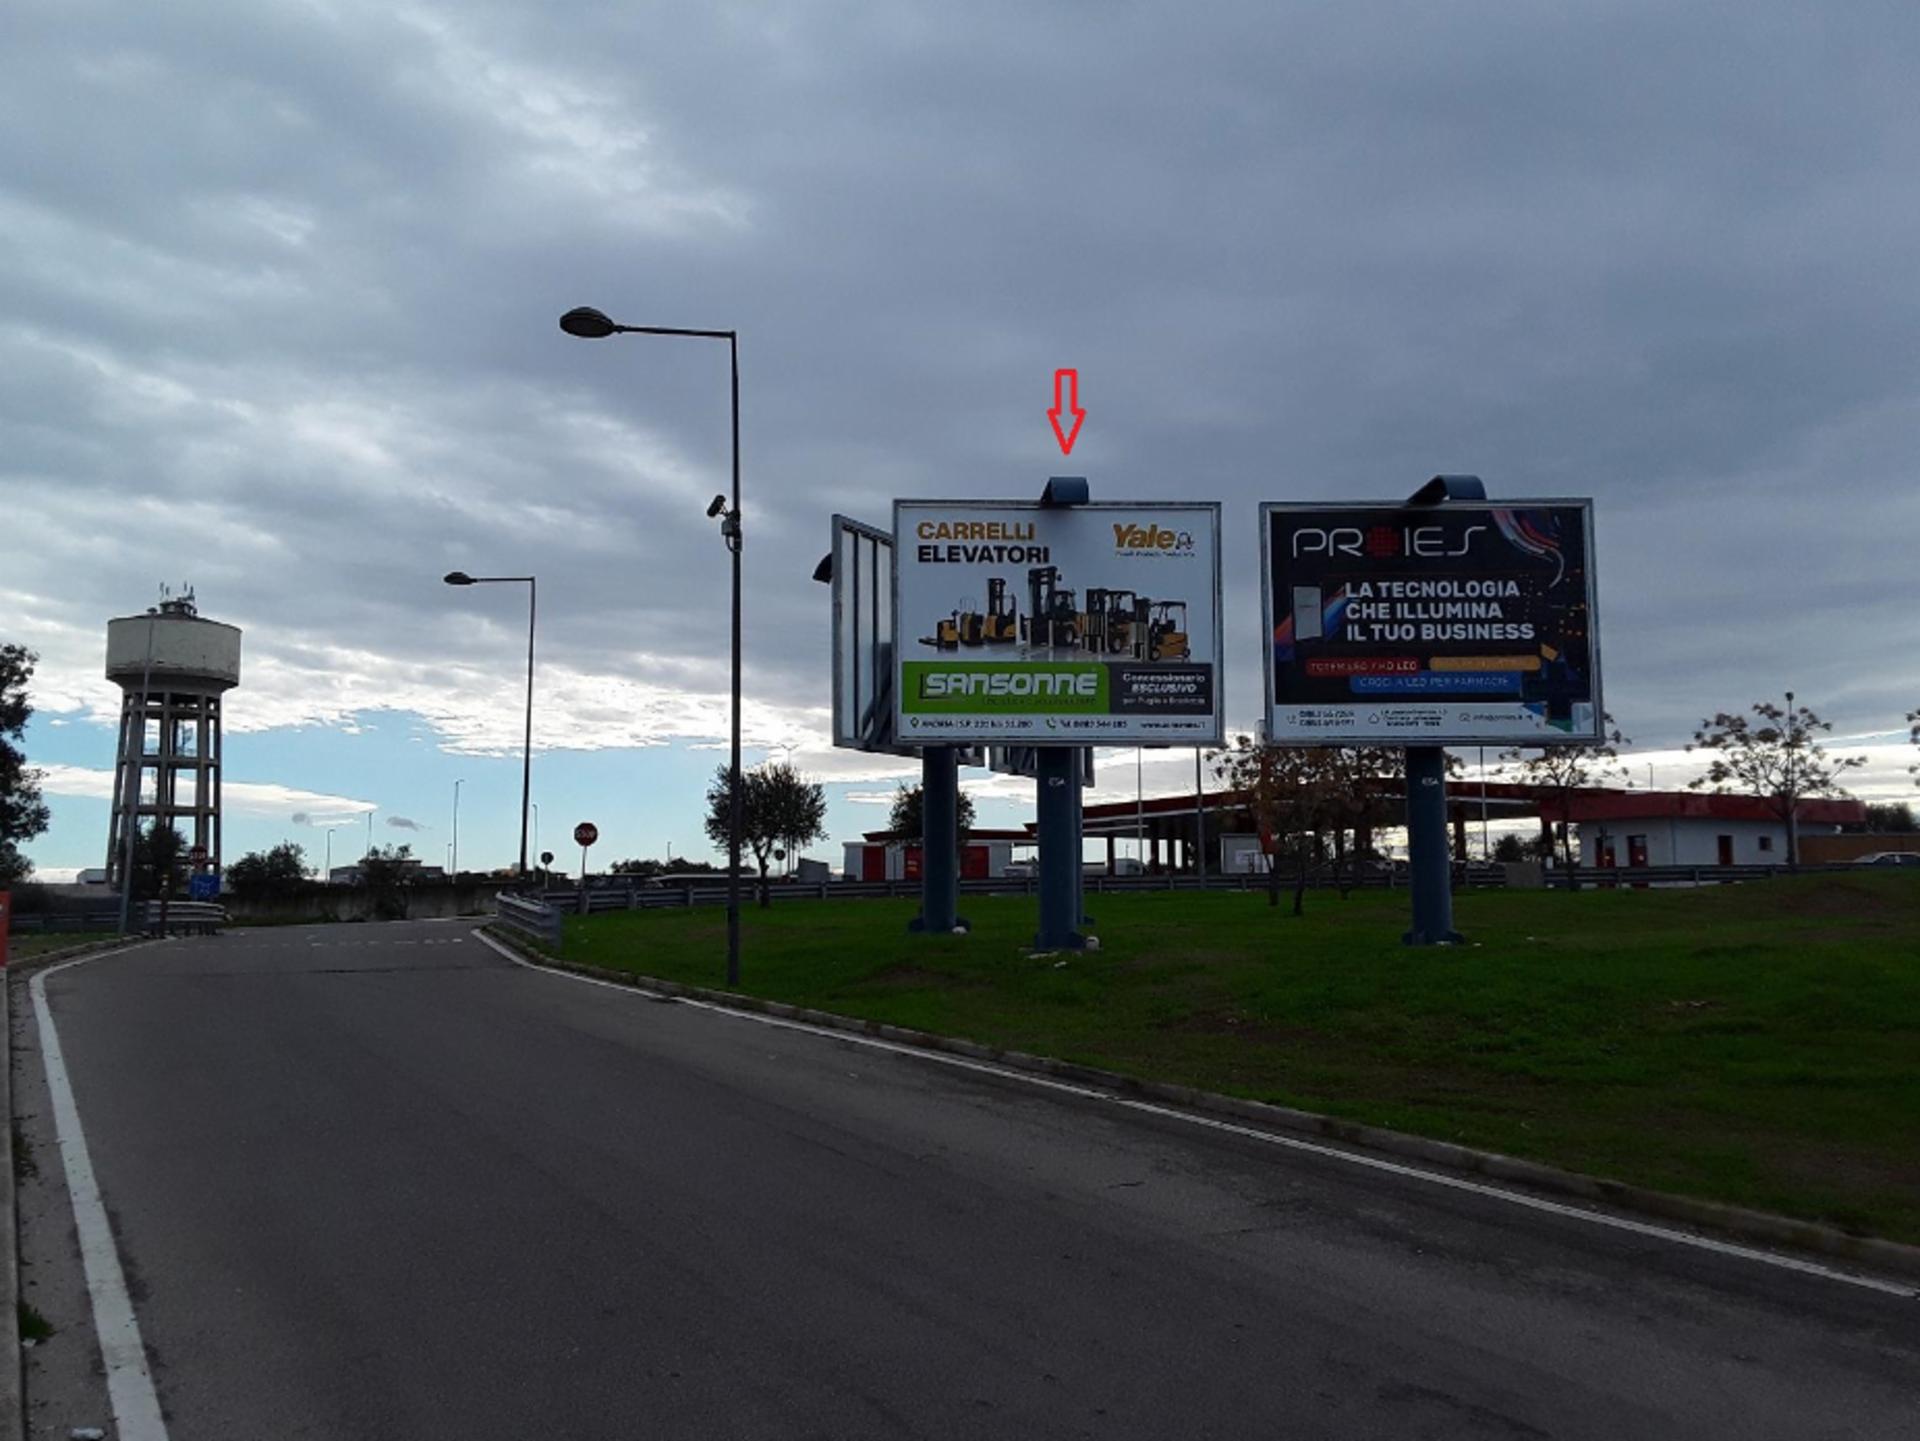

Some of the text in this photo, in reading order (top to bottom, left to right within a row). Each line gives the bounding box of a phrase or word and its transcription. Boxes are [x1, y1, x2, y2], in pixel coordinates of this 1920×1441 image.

[917, 522, 1036, 541] CARRELLI
[1113, 523, 1175, 550] Yale
[917, 545, 1050, 564] ELEVATORI
[1345, 580, 1520, 599] LA TECNOLOGIA
[1346, 601, 1503, 620] CHE ILLUMINA
[1347, 622, 1535, 641] IL TUO BUSINESS
[925, 672, 1098, 697] SANSONNE
[1131, 683, 1197, 693] ESCLUSIVO
